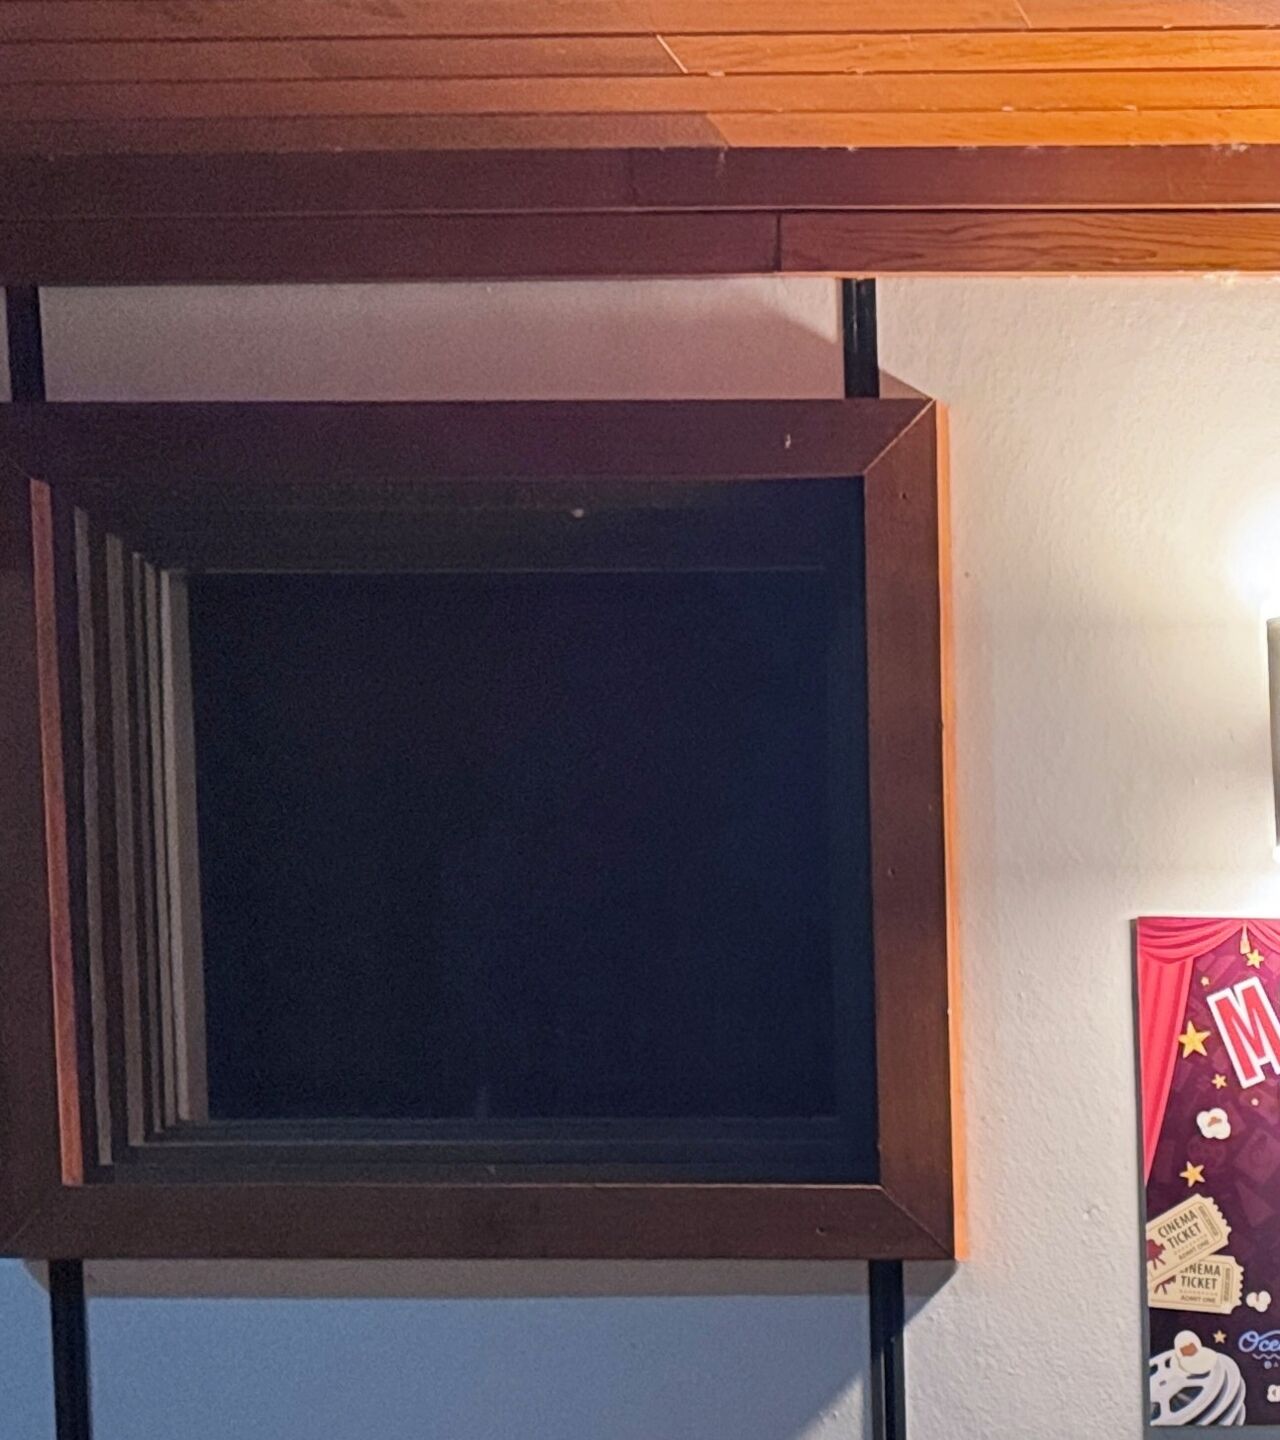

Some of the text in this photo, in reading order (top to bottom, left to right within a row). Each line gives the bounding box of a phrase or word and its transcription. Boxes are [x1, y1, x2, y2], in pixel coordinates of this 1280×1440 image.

[1158, 1210, 1198, 1239] CINEMA
[1167, 1223, 1202, 1248] TICKET
[1181, 1275, 1218, 1290] TICKET
